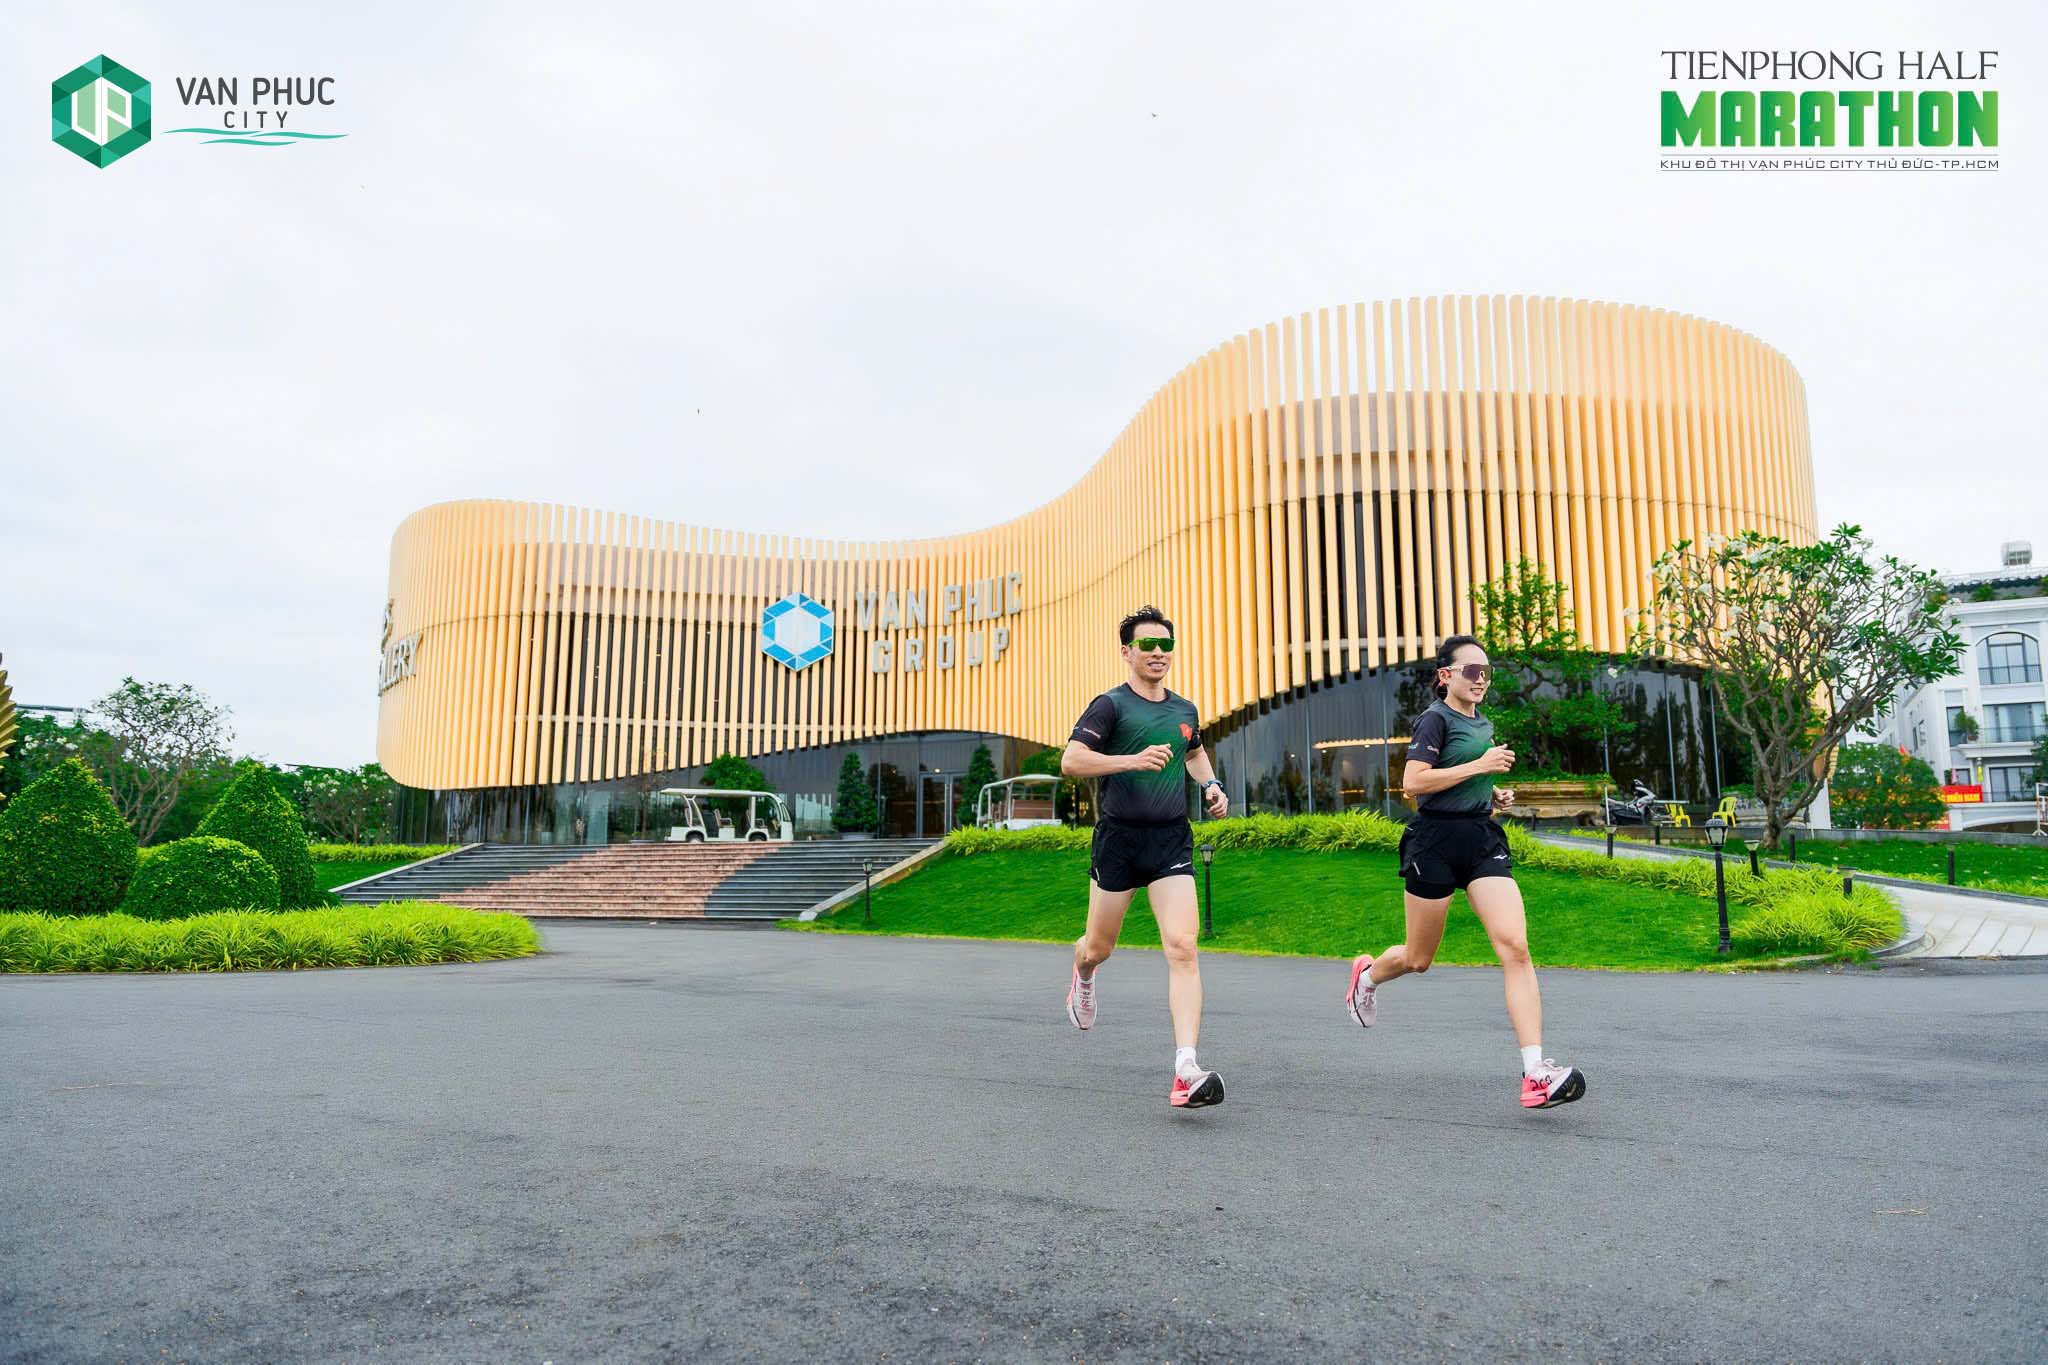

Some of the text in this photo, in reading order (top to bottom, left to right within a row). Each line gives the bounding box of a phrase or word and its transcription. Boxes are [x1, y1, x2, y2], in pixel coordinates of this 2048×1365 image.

[855, 572, 1023, 631] VAN PHUC
[872, 626, 1010, 673] GROUP
